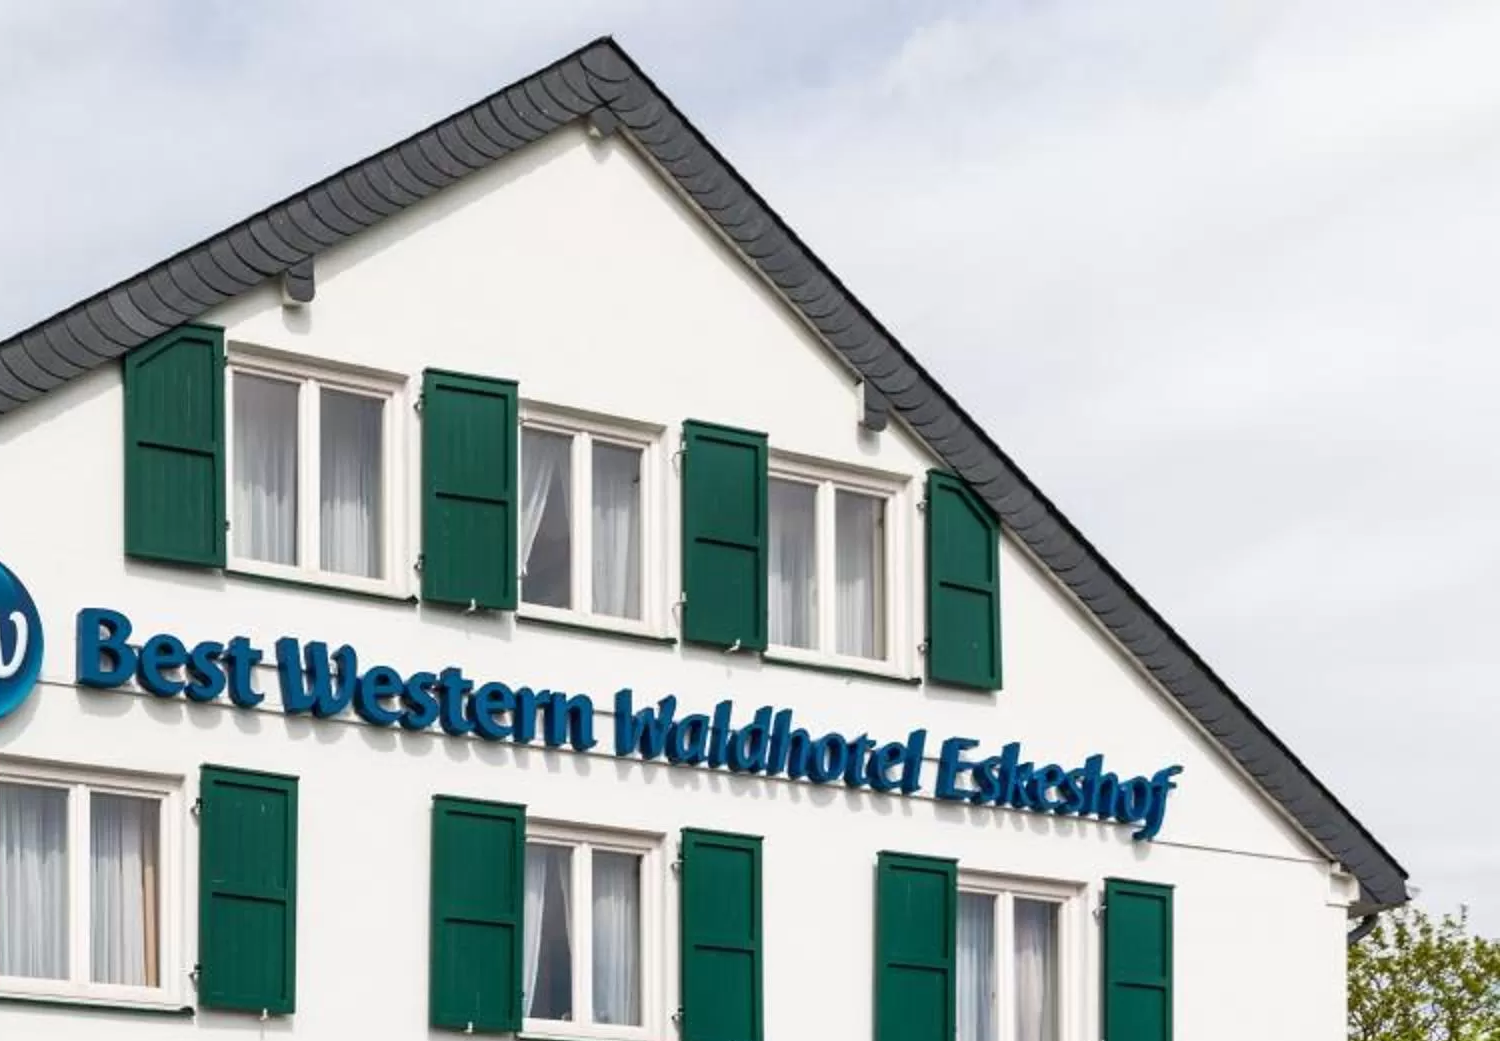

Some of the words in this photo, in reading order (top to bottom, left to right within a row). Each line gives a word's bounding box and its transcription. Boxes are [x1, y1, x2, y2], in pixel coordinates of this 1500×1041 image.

[76, 607, 265, 707] Best
[275, 637, 598, 752] Western
[614, 688, 927, 796] Waldhotel
[934, 736, 1184, 841] Eskeshof
